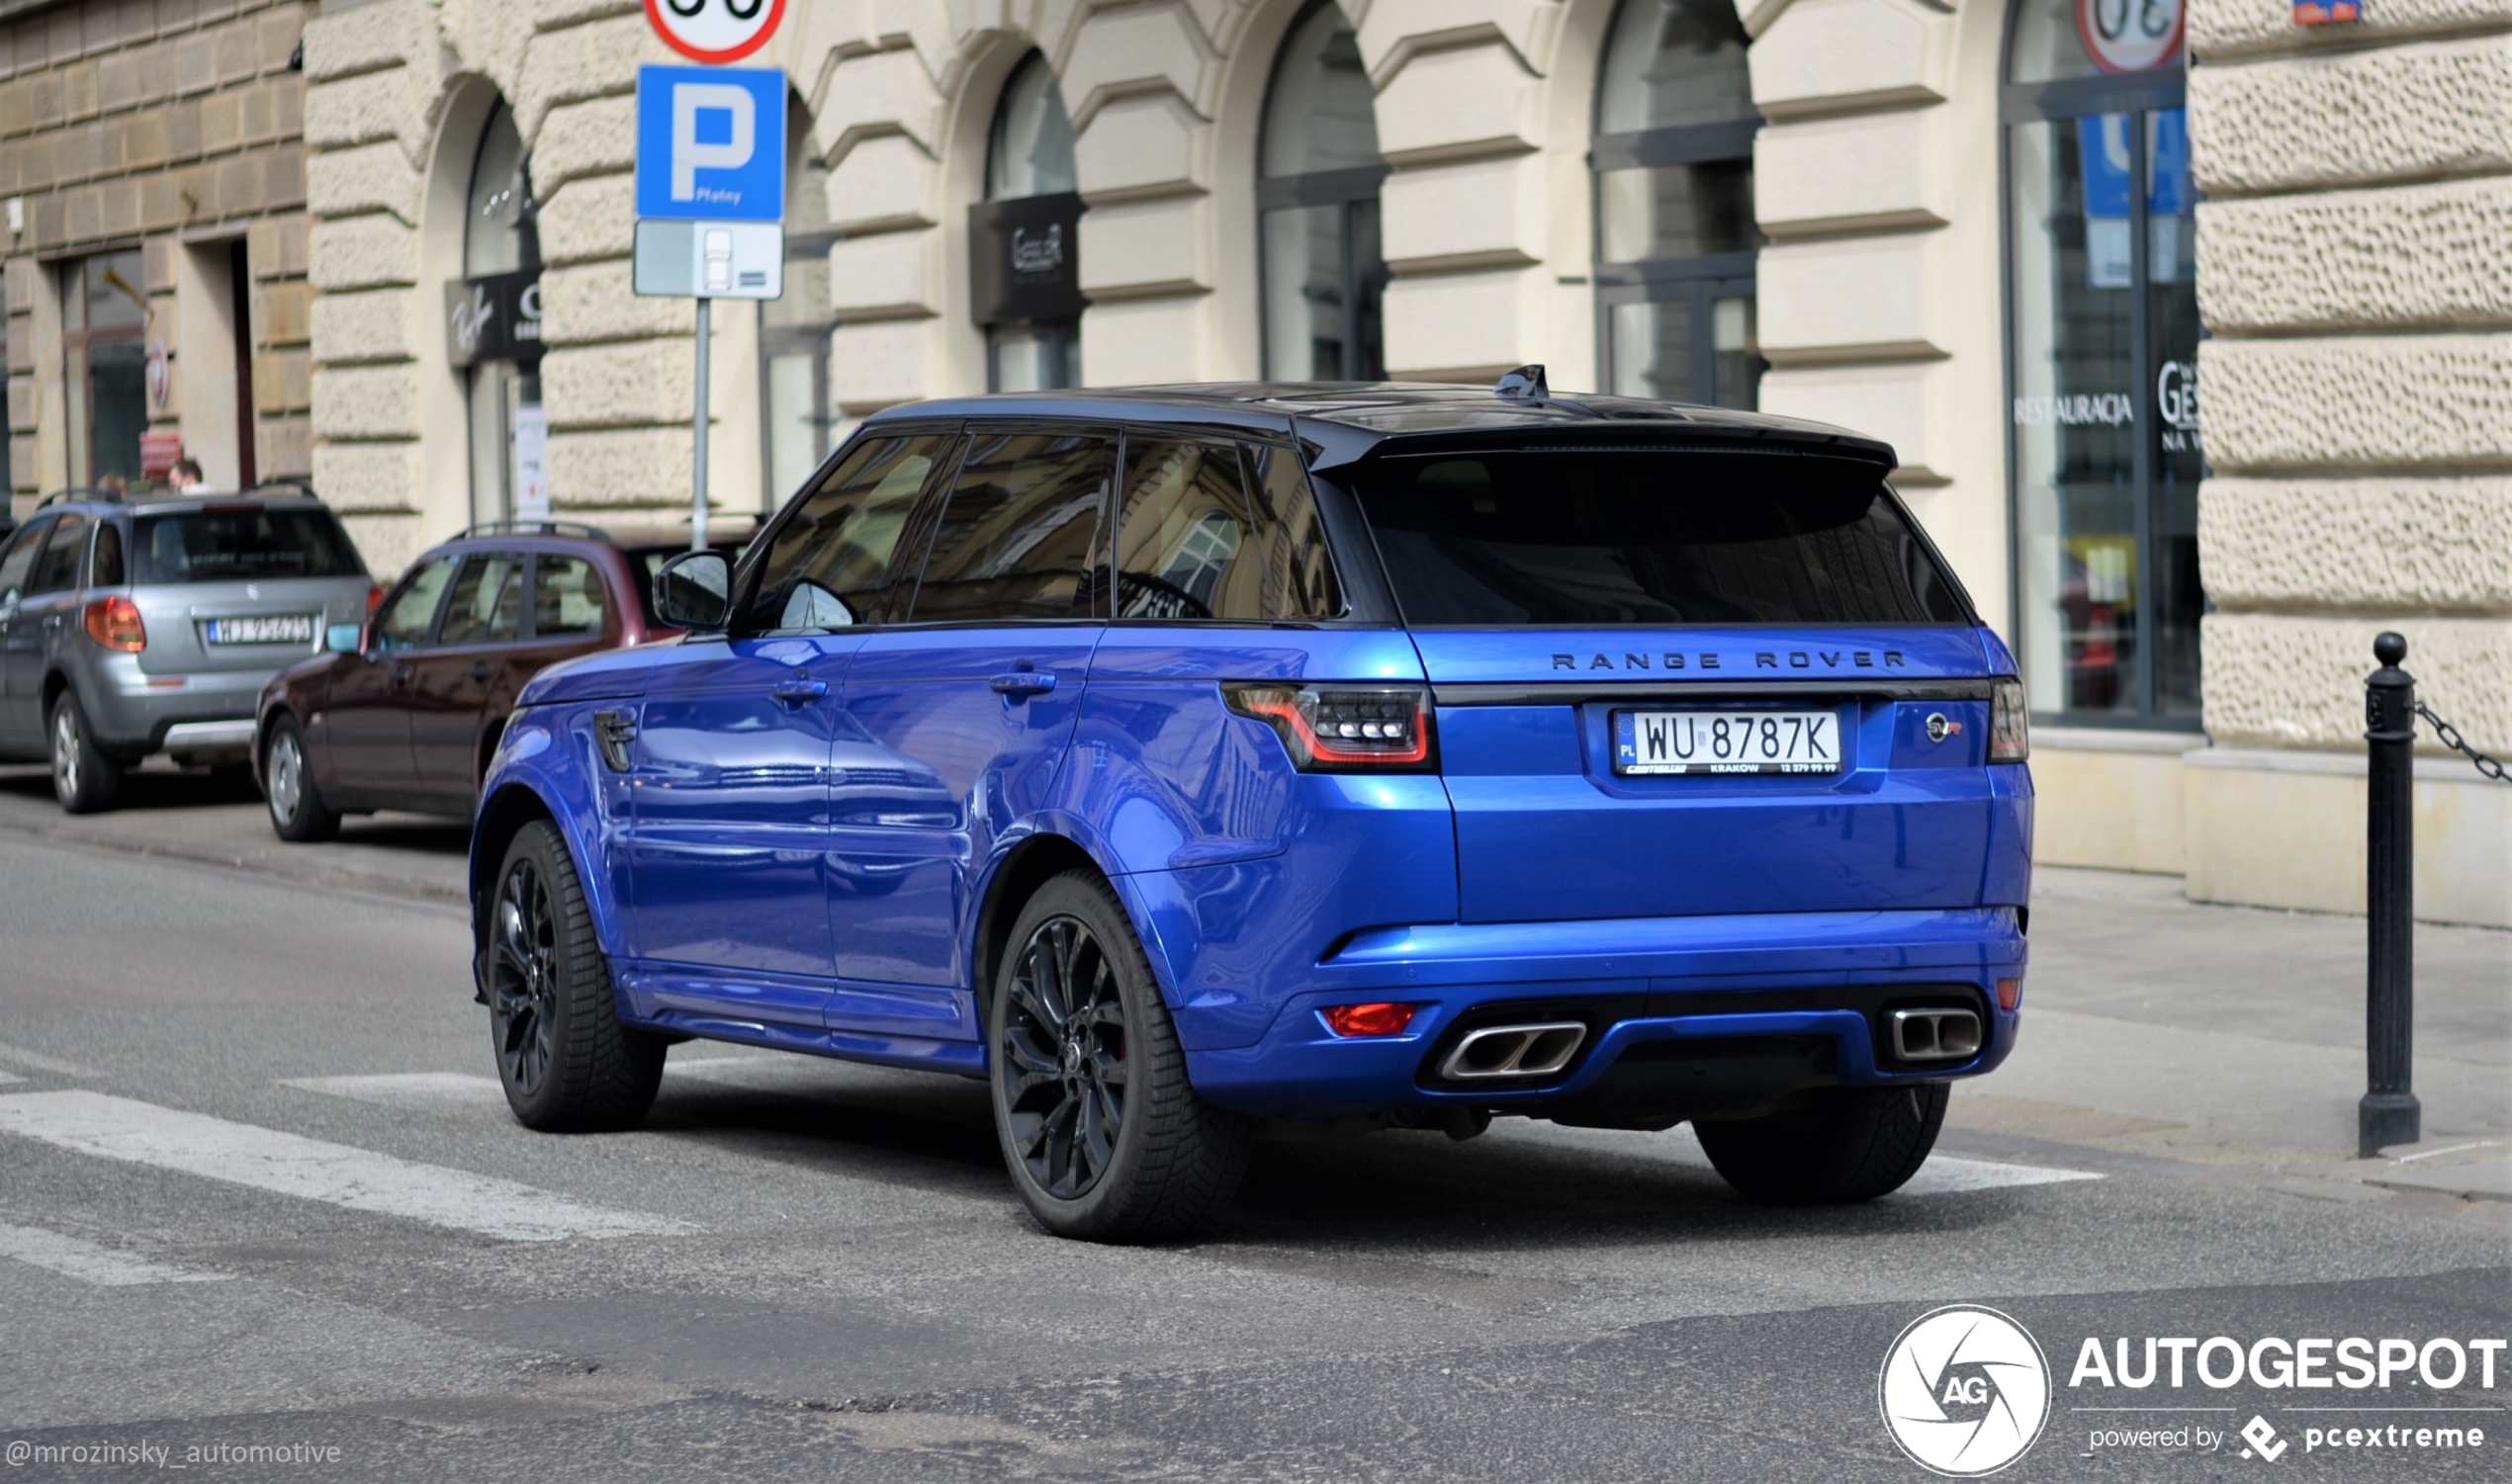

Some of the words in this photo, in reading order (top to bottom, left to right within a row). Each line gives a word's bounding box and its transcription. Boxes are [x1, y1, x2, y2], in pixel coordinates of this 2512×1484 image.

[671, 82, 757, 202] P
[2014, 393, 2134, 427] RESTAURACJA
[2162, 431, 2188, 452] NA
[1551, 652, 1721, 670] RANGE
[1754, 651, 1906, 668] ROVER
[1620, 743, 1636, 757] PL
[1645, 717, 1695, 760] WU
[1711, 716, 1830, 760] 8787K
[1927, 722, 1962, 736] SVR
[1780, 763, 1791, 773] 12
[1792, 763, 1809, 773] 379
[1810, 763, 1823, 773] 99
[1824, 763, 1837, 773] 99
